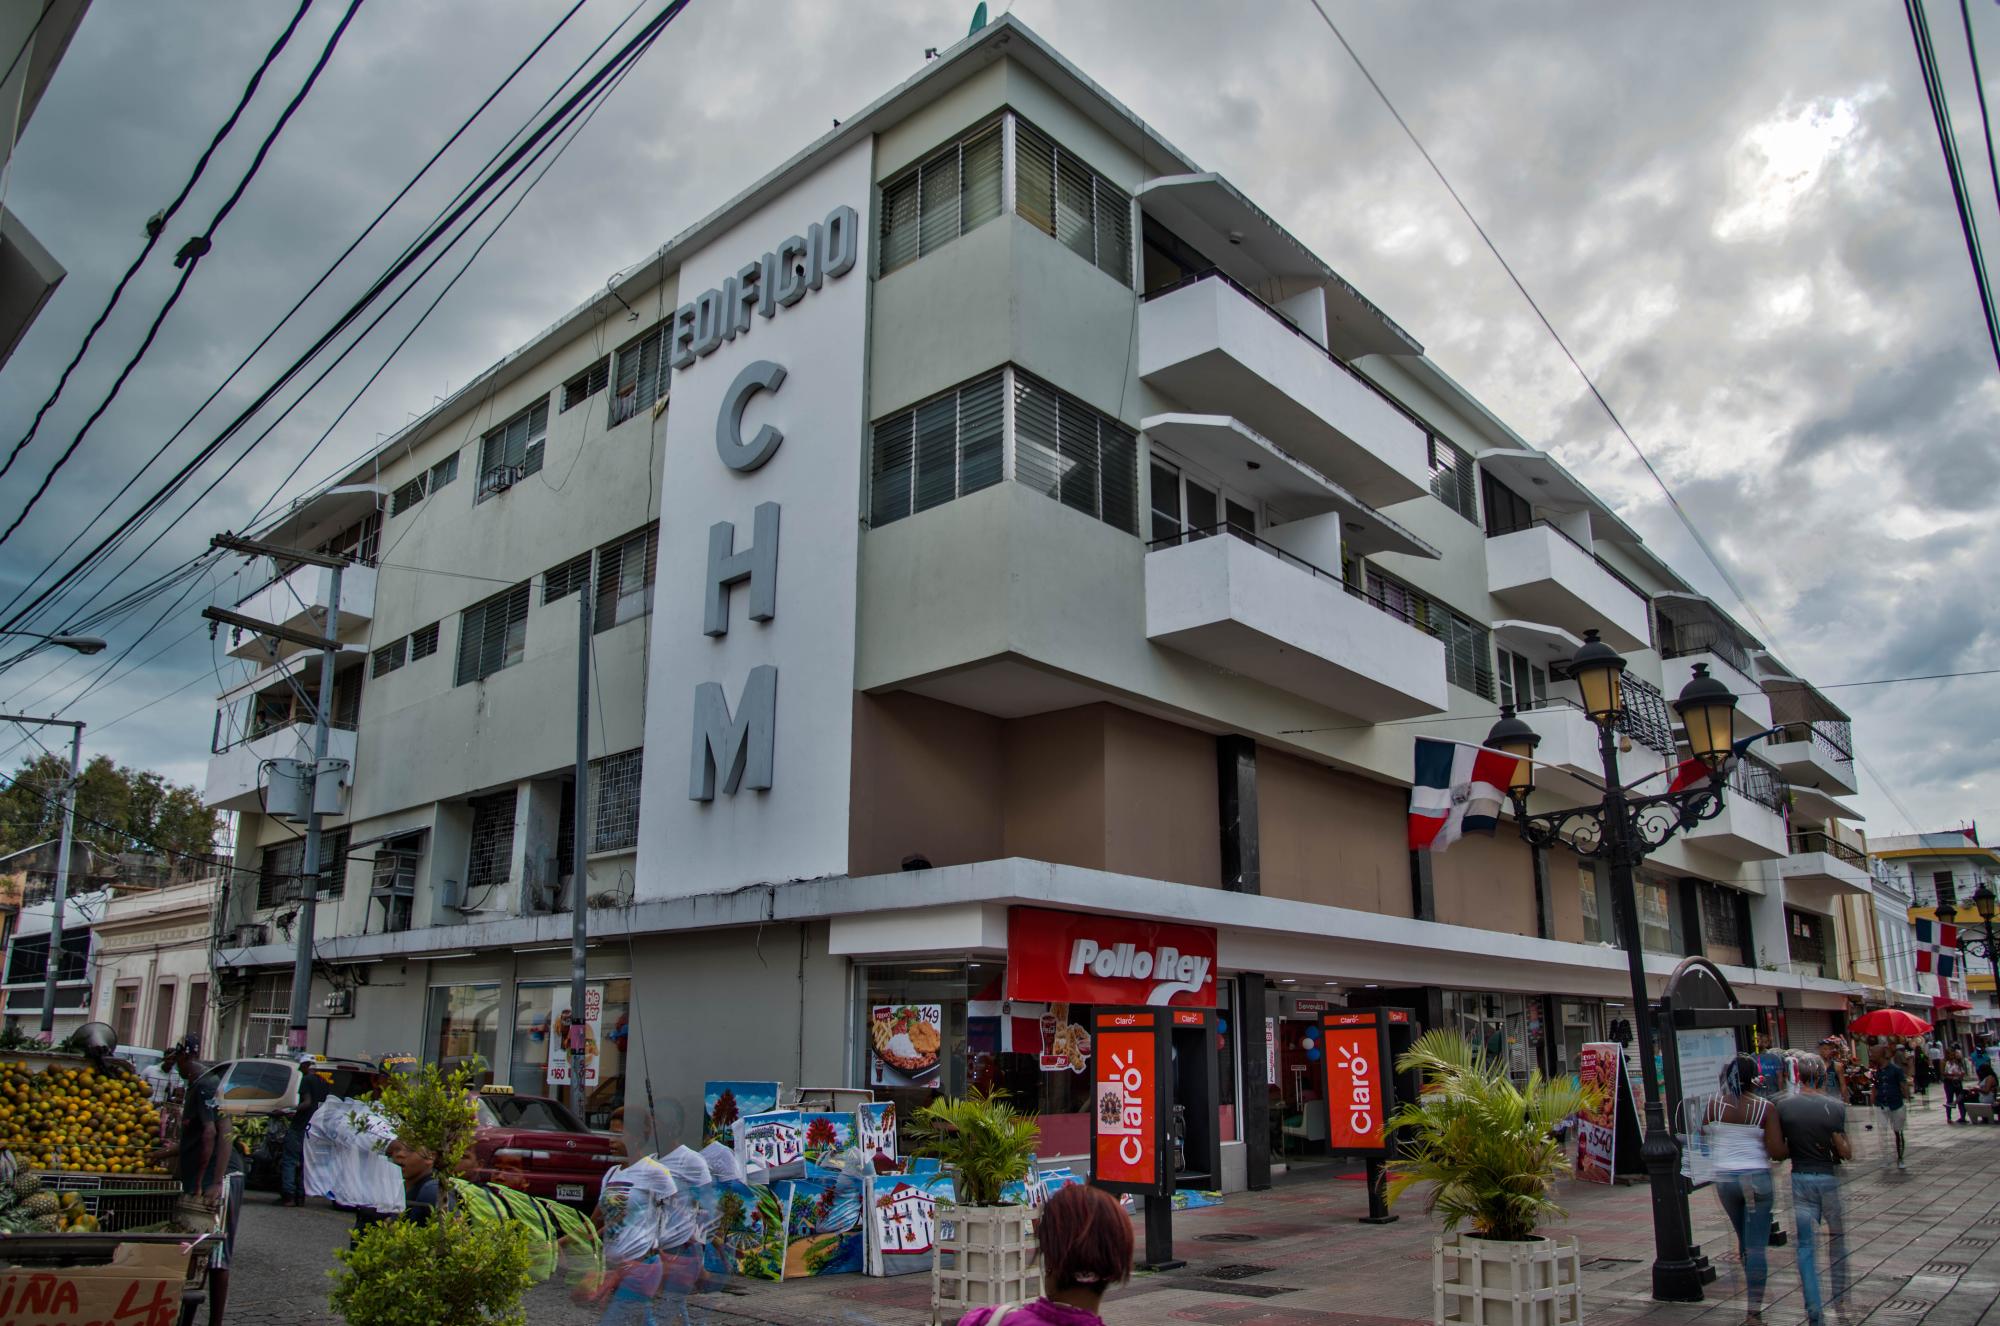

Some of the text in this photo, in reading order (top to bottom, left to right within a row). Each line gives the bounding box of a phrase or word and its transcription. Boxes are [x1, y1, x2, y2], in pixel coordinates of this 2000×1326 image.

[671, 204, 859, 370] EDIFICIO
[1068, 938, 1154, 980] Pollo
[585, 991, 600, 1006] ble
[585, 1008, 599, 1021] der
[918, 1007, 939, 1024] $149
[1115, 1016, 1133, 1024] Claro
[1340, 1016, 1358, 1024] Claro
[1346, 1052, 1372, 1134] Claro
[1116, 1062, 1143, 1165] Claro
